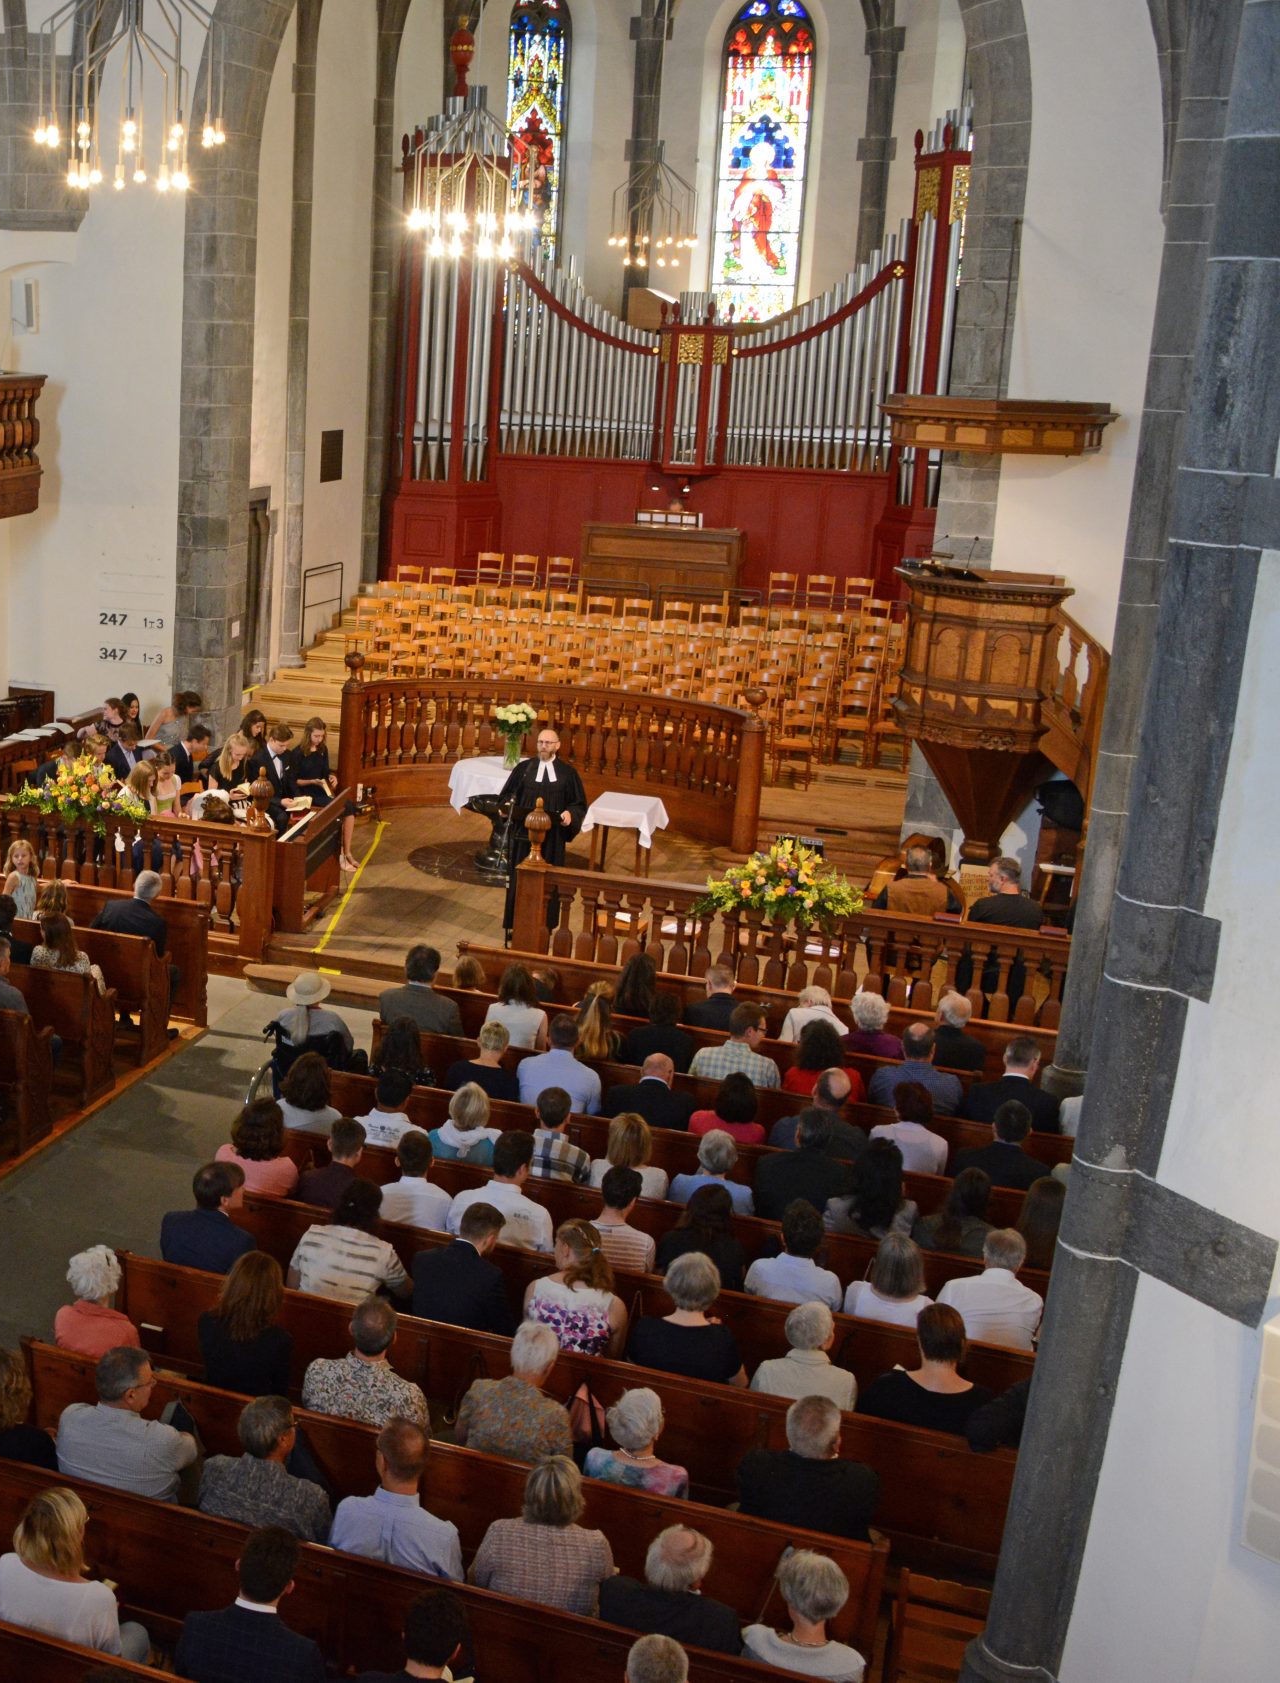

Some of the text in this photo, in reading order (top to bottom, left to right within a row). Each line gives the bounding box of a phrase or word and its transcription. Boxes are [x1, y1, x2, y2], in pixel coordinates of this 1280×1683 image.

[99, 612, 164, 629] 247 1-3
[99, 647, 163, 665] 347 1-3
